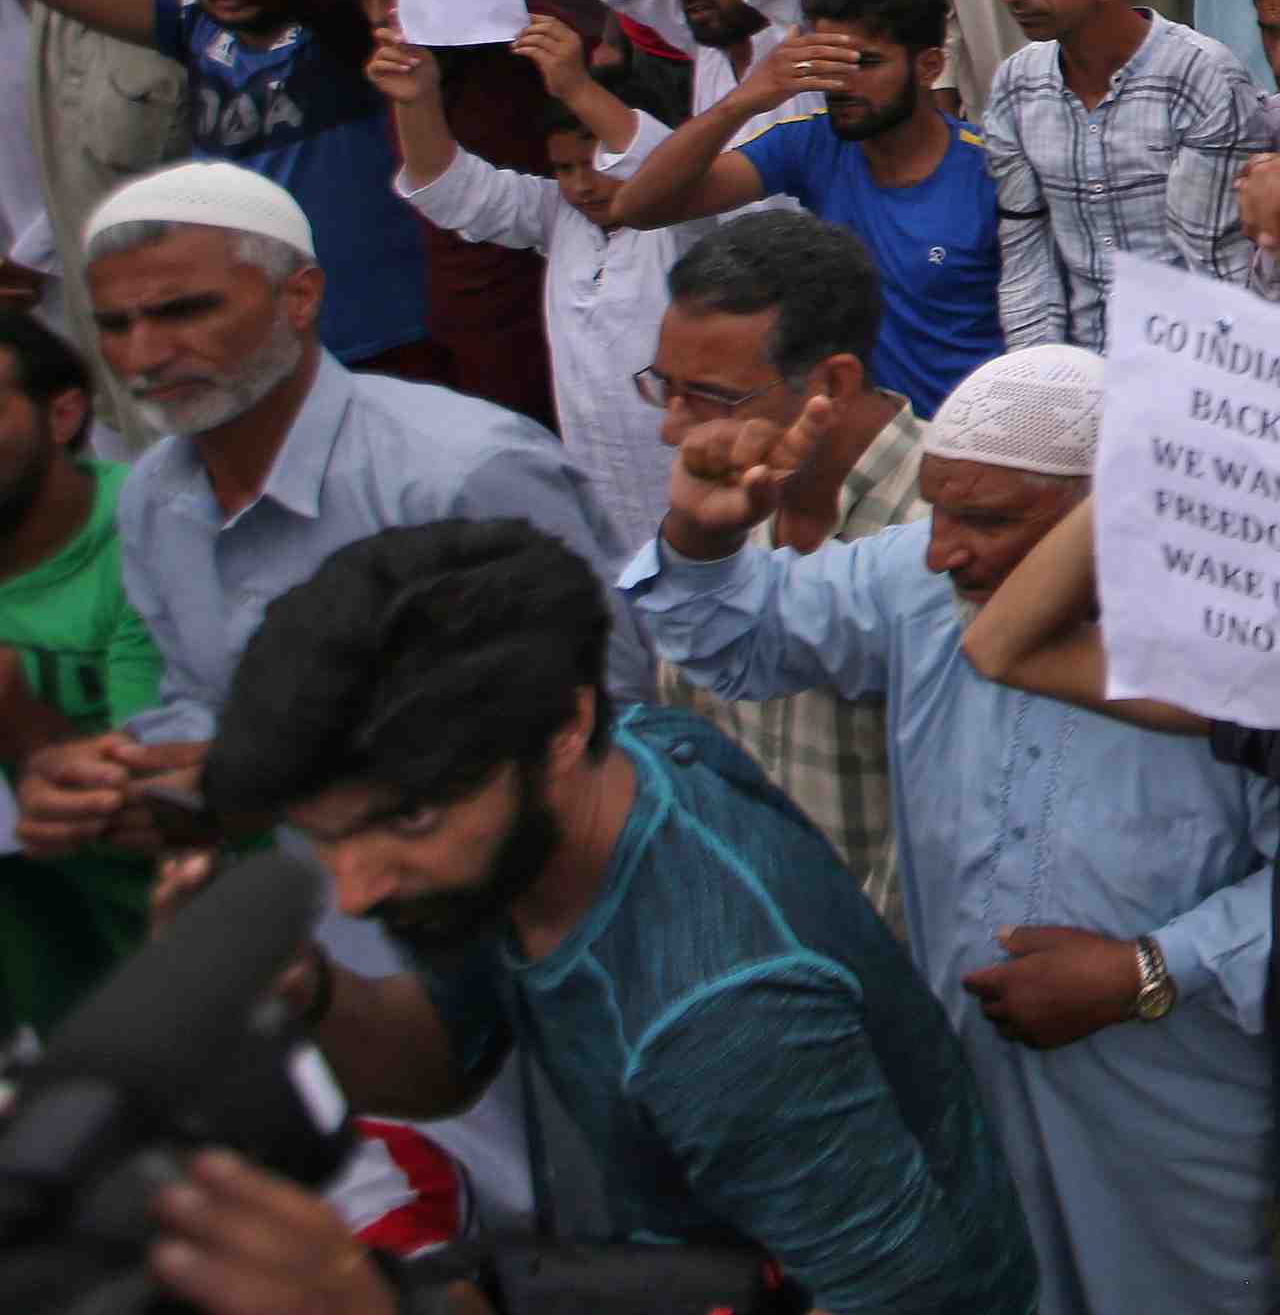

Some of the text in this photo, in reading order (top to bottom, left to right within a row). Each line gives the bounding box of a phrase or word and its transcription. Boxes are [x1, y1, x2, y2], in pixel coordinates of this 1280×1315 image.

[1145, 314, 1188, 354] GO
[1151, 437, 1205, 479] WE
[1160, 542, 1266, 600] WAKE
[1203, 606, 1276, 653] UNO
